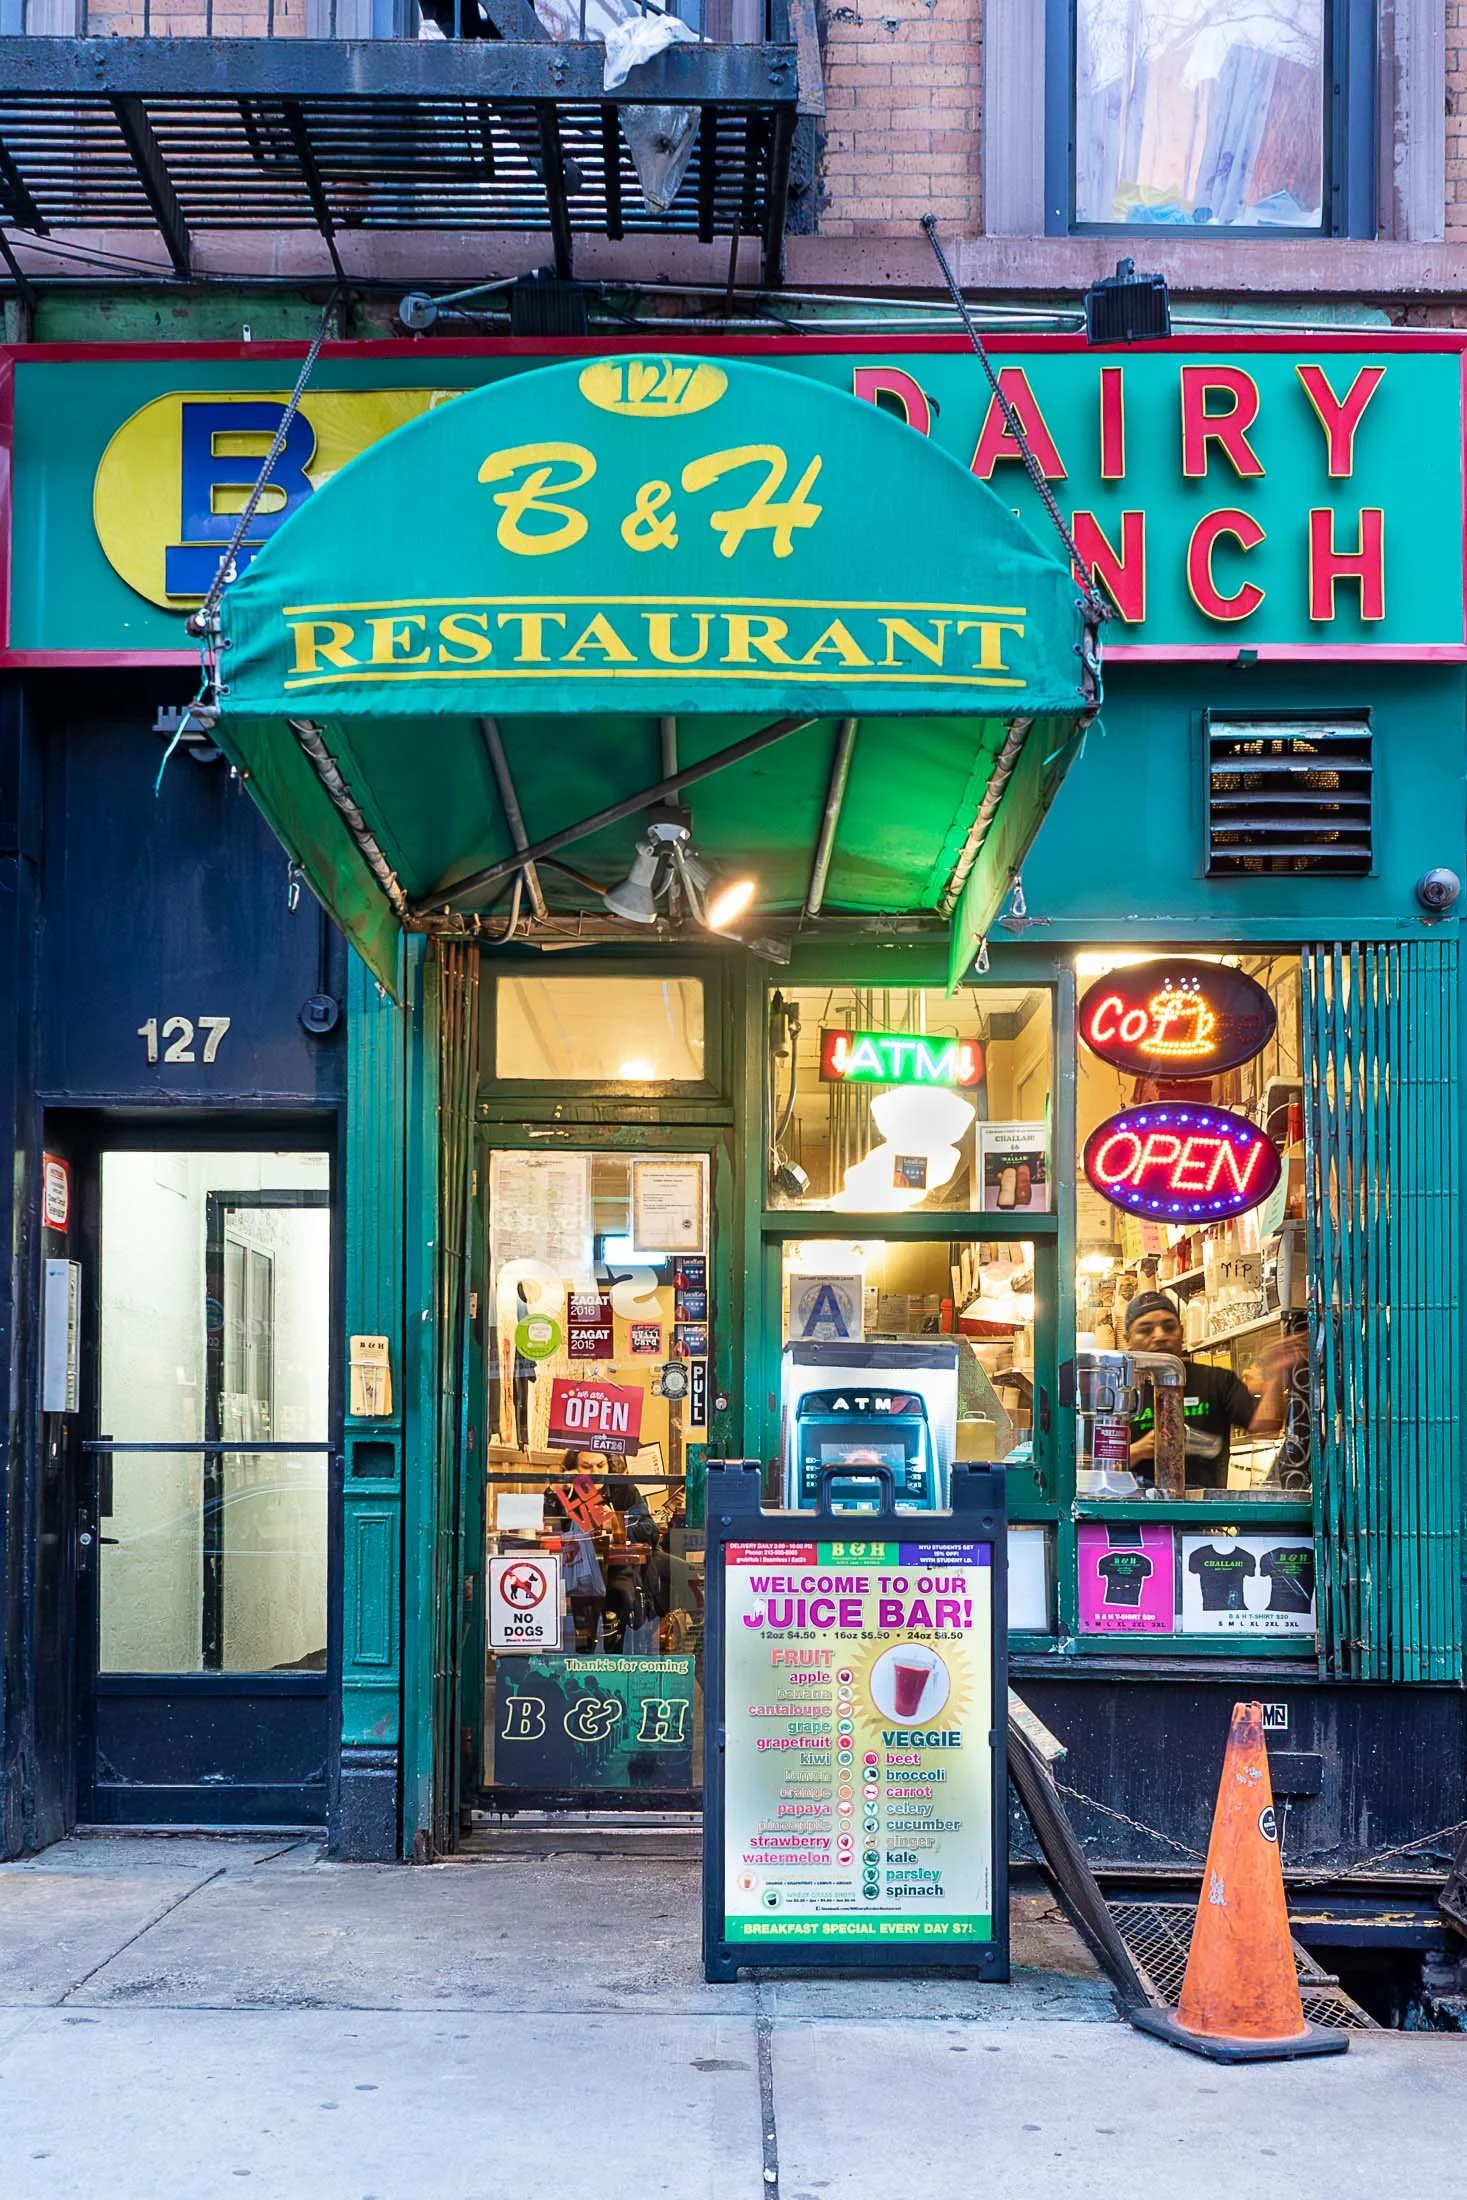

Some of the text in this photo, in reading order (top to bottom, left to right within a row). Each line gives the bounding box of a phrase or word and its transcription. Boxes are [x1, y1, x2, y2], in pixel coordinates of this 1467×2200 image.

[612, 360, 698, 405] 127
[853, 365, 1386, 480] DAIRY
[478, 441, 823, 558] B & H
[1068, 508, 1386, 623] NCH
[287, 611, 1026, 674] RESTAURANT
[137, 1016, 231, 1063] 127
[846, 1039, 956, 1081] ATM
[1096, 1131, 1262, 1194] OPEN
[570, 1296, 609, 1305] ZAGAT
[571, 1305, 595, 1316] 2016
[802, 1285, 849, 1337] A
[571, 1330, 610, 1339] ZAGAT
[571, 1340, 595, 1350] 2015
[693, 1366, 705, 1421] PULL
[832, 1398, 892, 1411] ATM
[566, 1398, 629, 1432] OPEN
[832, 1542, 885, 1556] B & H
[750, 1577, 967, 1593] WELCOME TO OUR
[514, 1613, 533, 1623] NO
[743, 1599, 972, 1628] JUICE BAR!
[504, 1626, 543, 1636] DOGS
[787, 1631, 816, 1639] $4.50
[771, 1650, 833, 1667] FRUIT
[565, 1659, 689, 1674] Thank's for coming
[790, 1671, 831, 1685] apple
[777, 1688, 832, 1700] banana
[749, 1703, 831, 1717] cantaloupe
[502, 1697, 689, 1742] B & H
[788, 1722, 831, 1734] grape
[757, 1737, 831, 1751] grapefruit
[882, 1731, 961, 1747] VEGGIE
[800, 1753, 831, 1765] kiwi
[886, 1753, 919, 1765] beet
[886, 1769, 945, 1781] broccoli
[780, 1786, 831, 1800] orange
[886, 1786, 932, 1798] carrot
[778, 1803, 831, 1816] papaya
[886, 1803, 933, 1817] celery
[758, 1819, 831, 1833] pineapple
[886, 1819, 961, 1831] cucumber
[750, 1835, 830, 1850] strawberry
[886, 1837, 935, 1850] ginger
[742, 1852, 830, 1864] watermelon
[886, 1851, 917, 1863] kale
[886, 1868, 941, 1883] parsley
[886, 1884, 944, 1899] spinach
[743, 1923, 818, 1934] BREAKFAST
[822, 1923, 876, 1934] SPECIAL
[879, 1923, 920, 1934] EVERY
[924, 1923, 949, 1934] DAY
